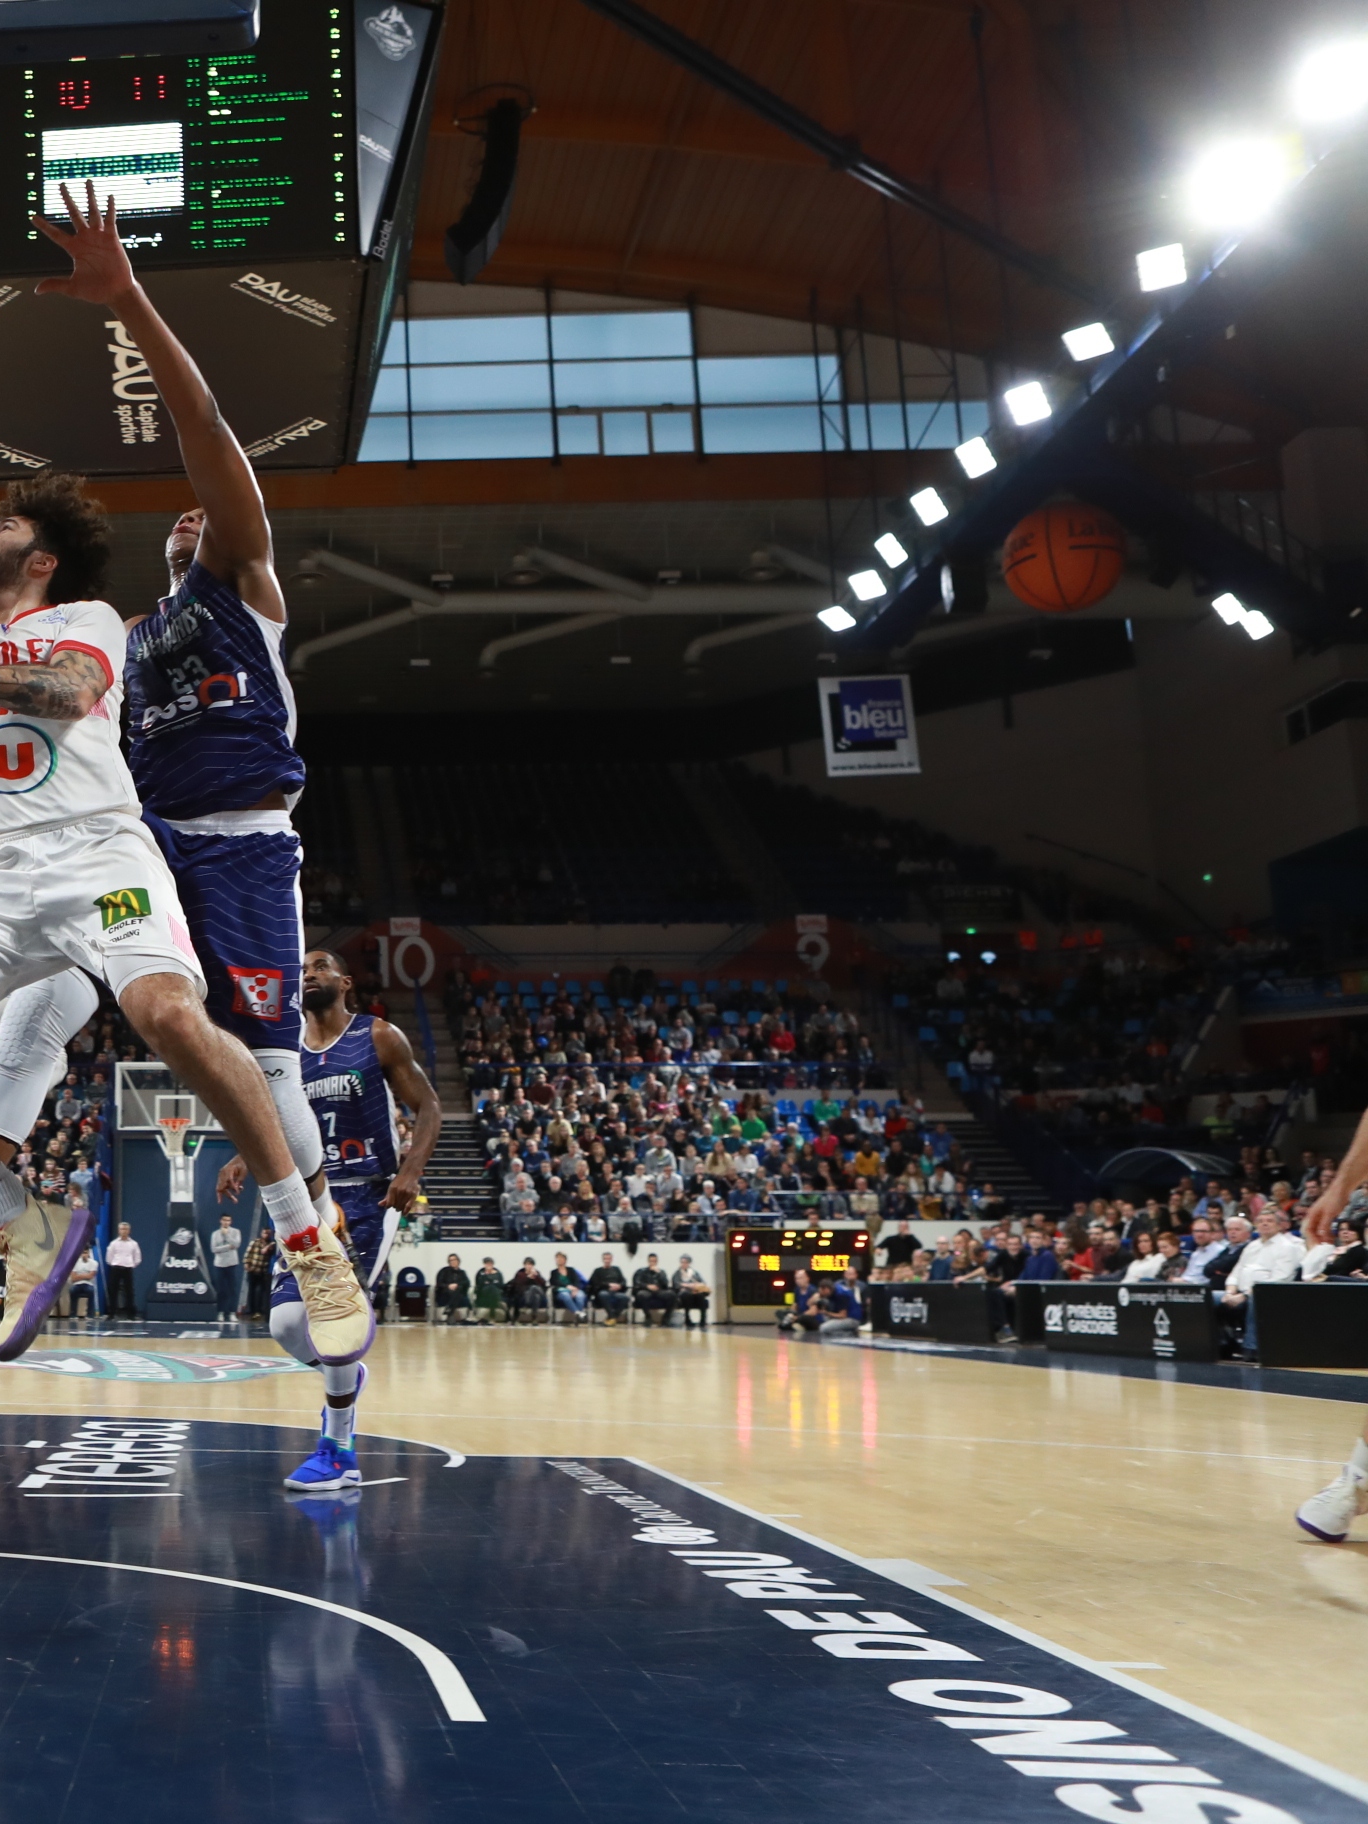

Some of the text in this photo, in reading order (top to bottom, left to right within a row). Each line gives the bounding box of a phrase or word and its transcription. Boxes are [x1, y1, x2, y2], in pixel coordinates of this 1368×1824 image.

[238, 272, 302, 303] PAU
[104, 320, 159, 401] PAU
[112, 404, 140, 444] sportive
[133, 403, 161, 443] Capitale
[843, 703, 905, 730] bleu
[108, 918, 145, 935] CHOLET
[375, 936, 436, 989] 10
[322, 1111, 337, 1138] 7
[164, 1256, 198, 1271] Jeep
[668, 1550, 866, 1602] PAU
[762, 1608, 985, 1662] DE
